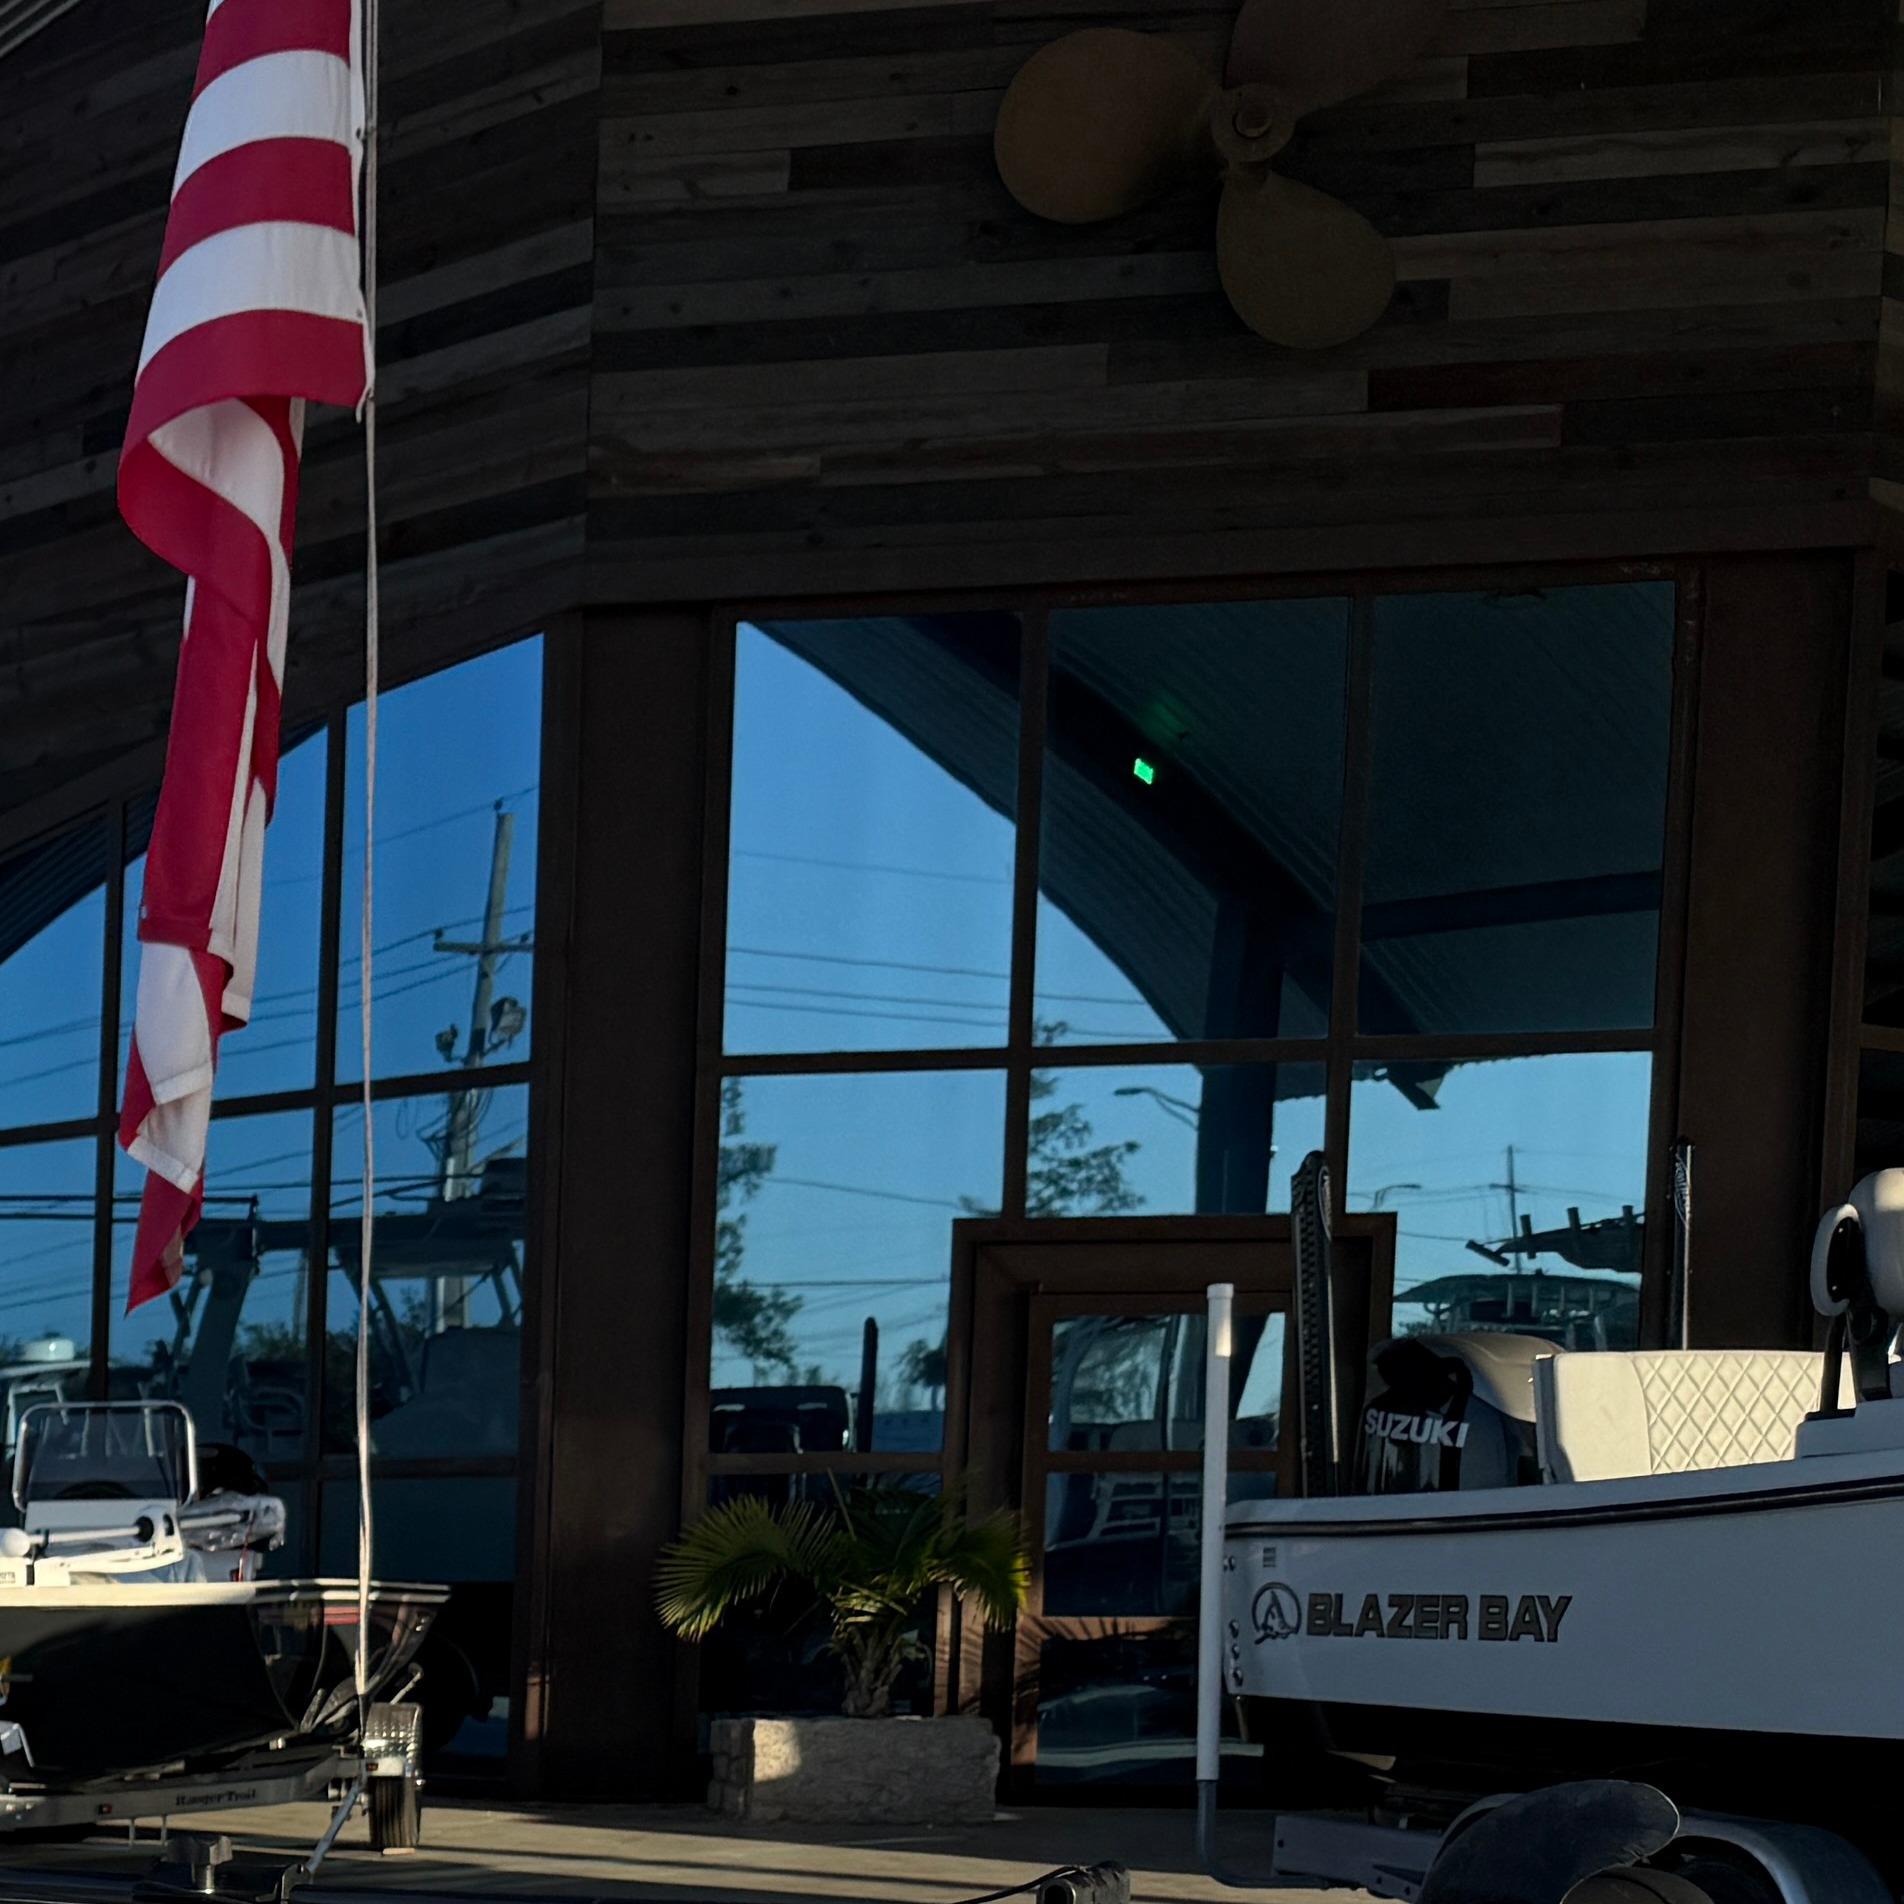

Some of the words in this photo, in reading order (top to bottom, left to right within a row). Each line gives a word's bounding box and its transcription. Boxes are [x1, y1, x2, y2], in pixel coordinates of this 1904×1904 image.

[1364, 1408, 1469, 1448] SUZUKI
[1306, 1592, 1469, 1640] BLAZER
[1478, 1594, 1573, 1642] BAY
